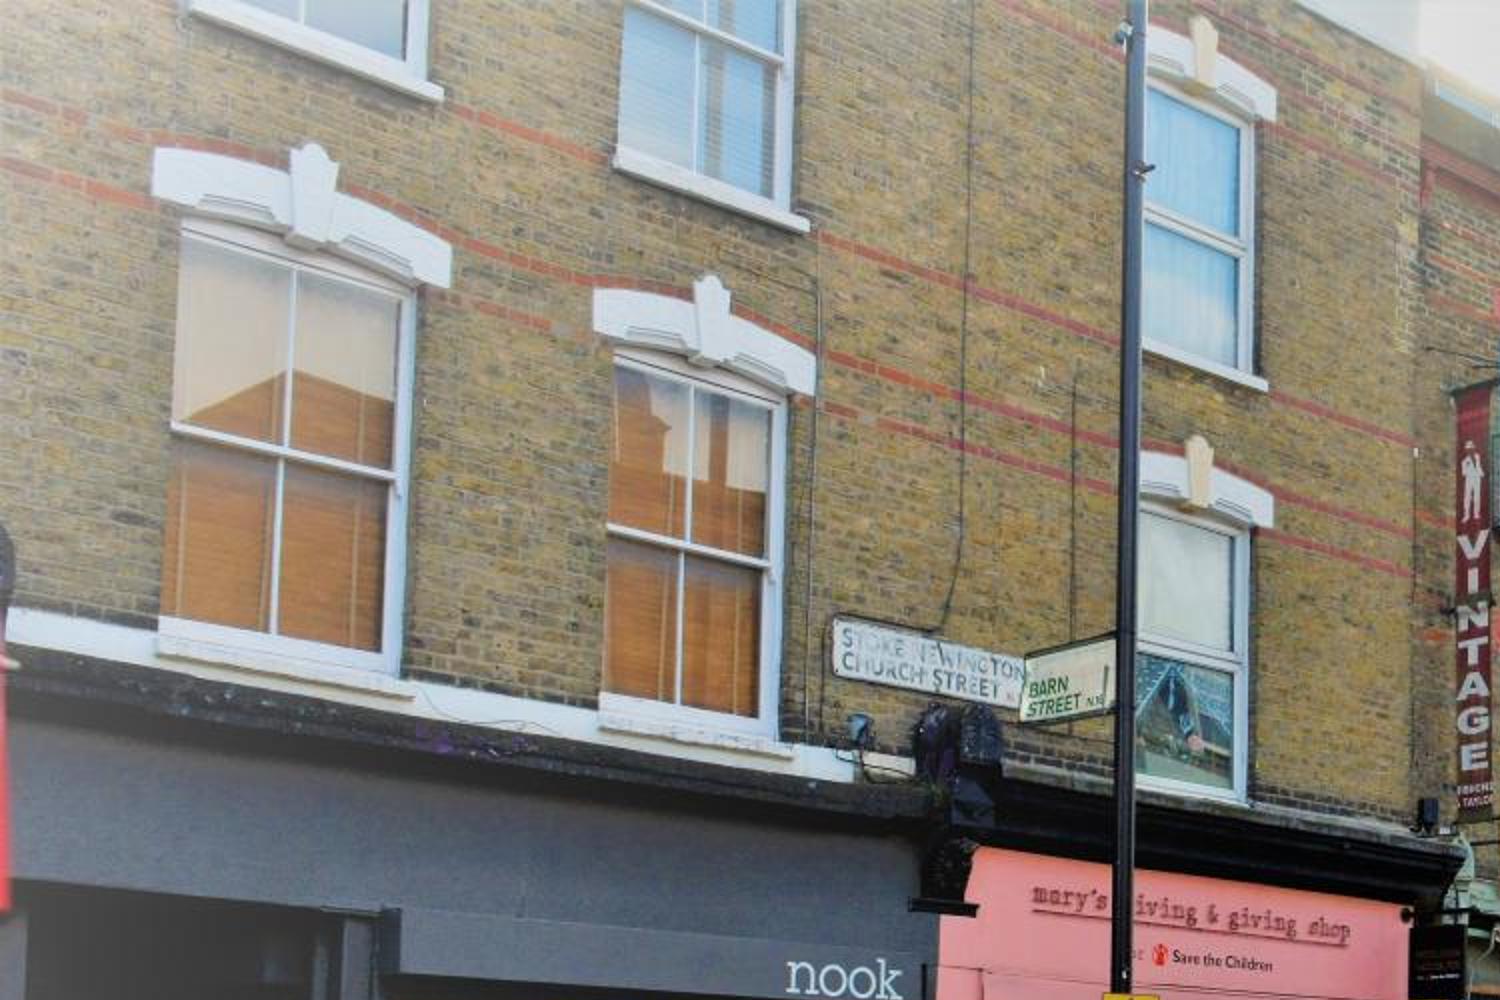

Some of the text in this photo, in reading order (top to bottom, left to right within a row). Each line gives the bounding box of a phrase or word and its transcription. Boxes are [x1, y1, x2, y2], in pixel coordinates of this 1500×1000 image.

[842, 627, 1026, 682] STOKE NEWINGTON
[1457, 528, 1490, 771] VINTAGE
[842, 652, 998, 698] CHURCH STREET
[1028, 675, 1069, 699] BARN
[1026, 692, 1081, 717] STREET
[1032, 886, 1351, 944] mary's iving & giving shop
[785, 957, 904, 1000] nook
[1172, 949, 1273, 973] Save the Children
